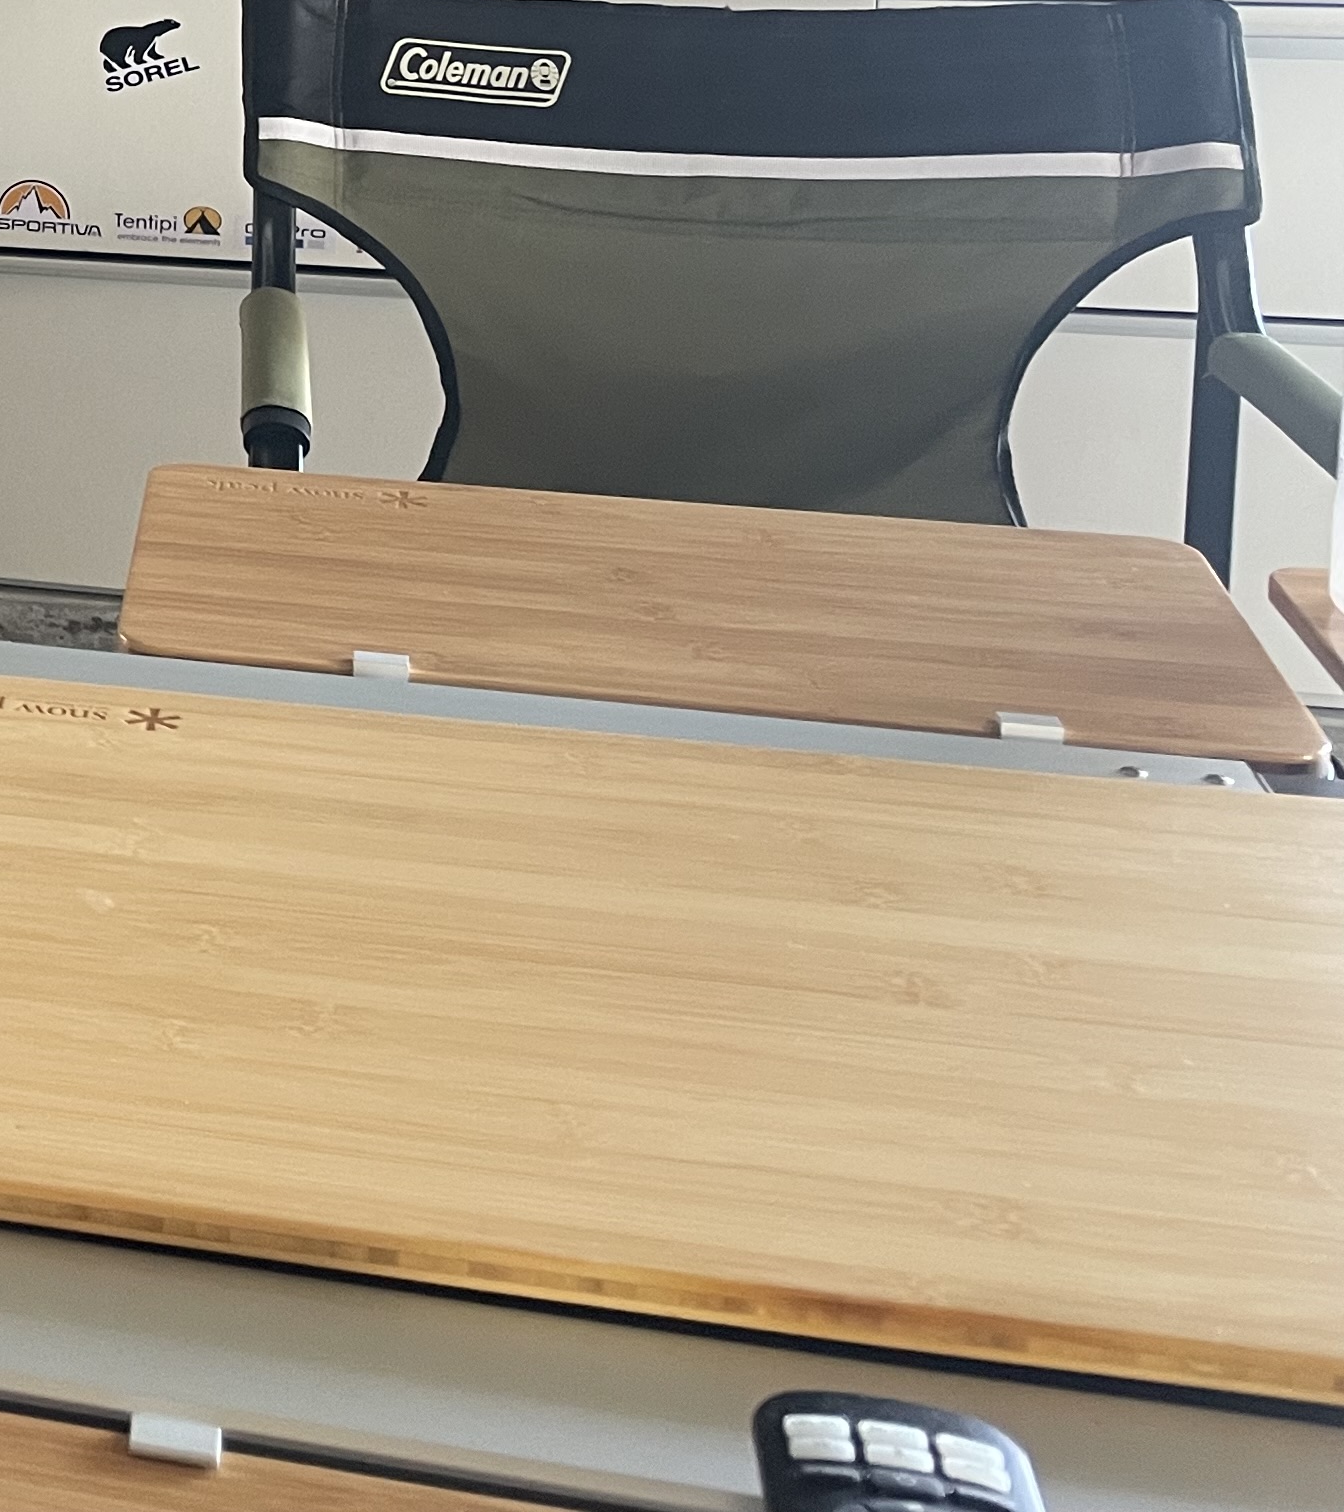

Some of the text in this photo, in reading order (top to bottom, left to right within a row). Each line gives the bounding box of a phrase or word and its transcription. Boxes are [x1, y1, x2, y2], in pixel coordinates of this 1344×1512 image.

[105, 56, 201, 92] SOREL
[399, 46, 529, 89] Coleman
[114, 212, 177, 232] Tentipi
[117, 234, 221, 247] embrace the elements
[286, 486, 364, 501] snow
[15, 702, 109, 722] snow
